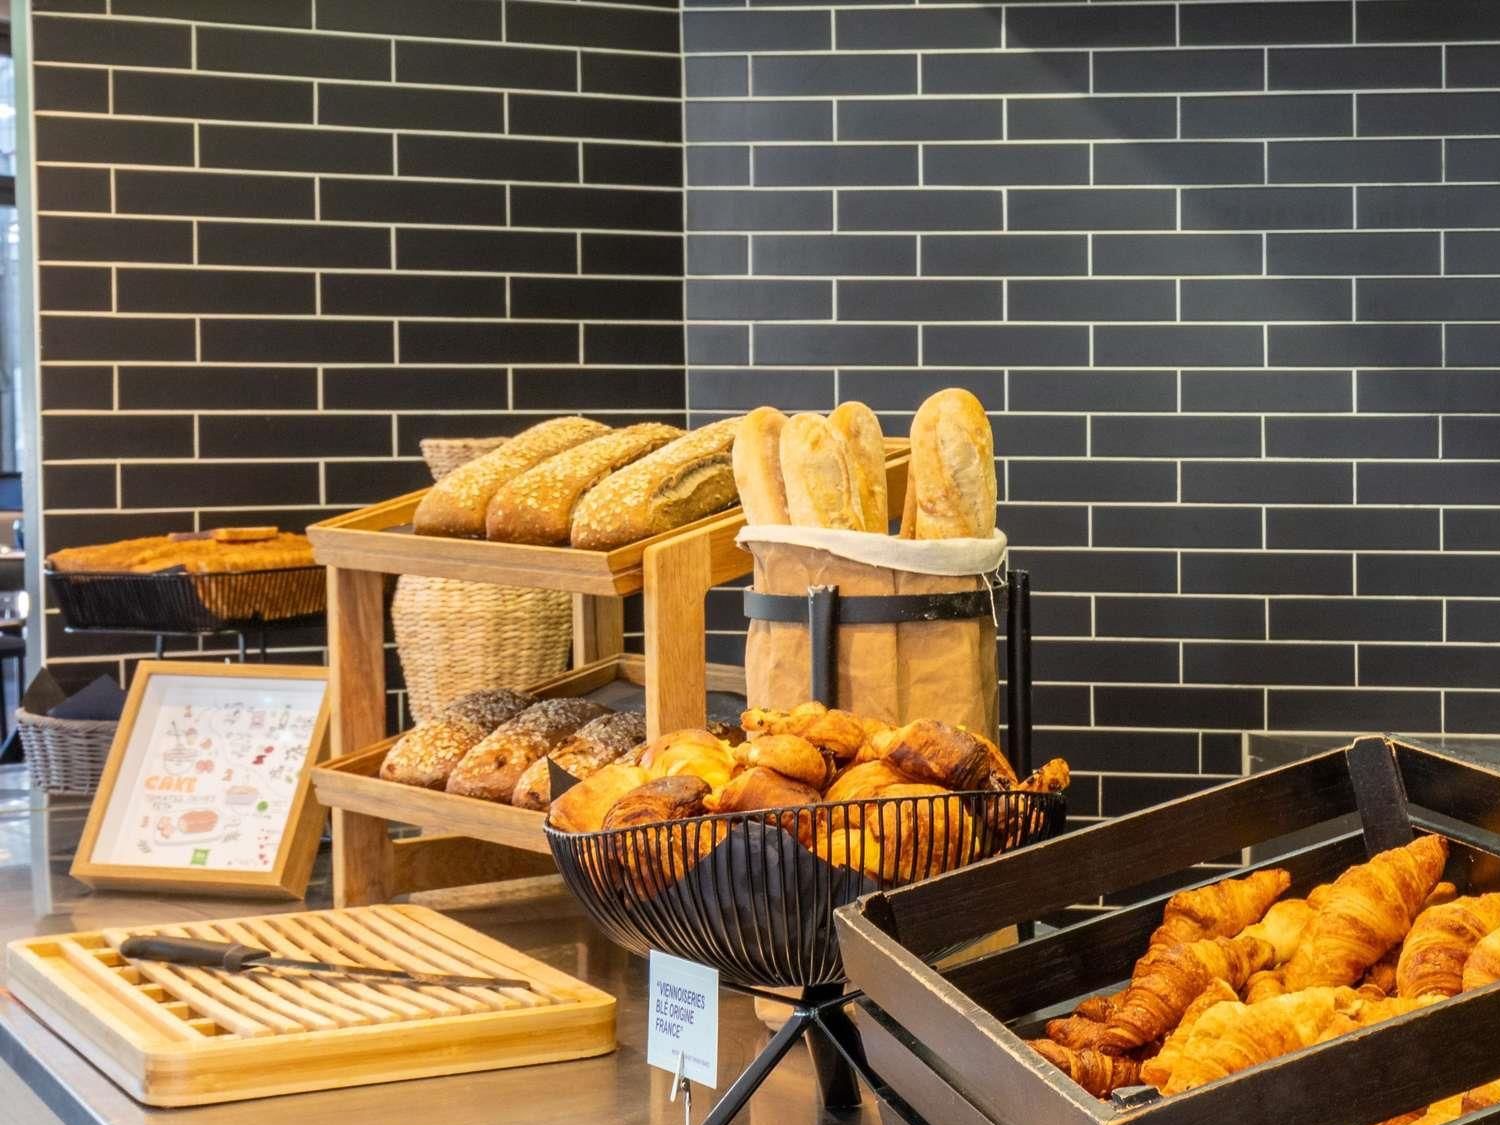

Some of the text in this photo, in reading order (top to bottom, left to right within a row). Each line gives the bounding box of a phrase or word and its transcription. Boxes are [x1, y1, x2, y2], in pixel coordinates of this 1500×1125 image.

[656, 980, 705, 1010] “VIENNOISERIES
[655, 999, 695, 1025] BLÉ ORIGINE
[655, 1017, 684, 1039] FRANCE”
